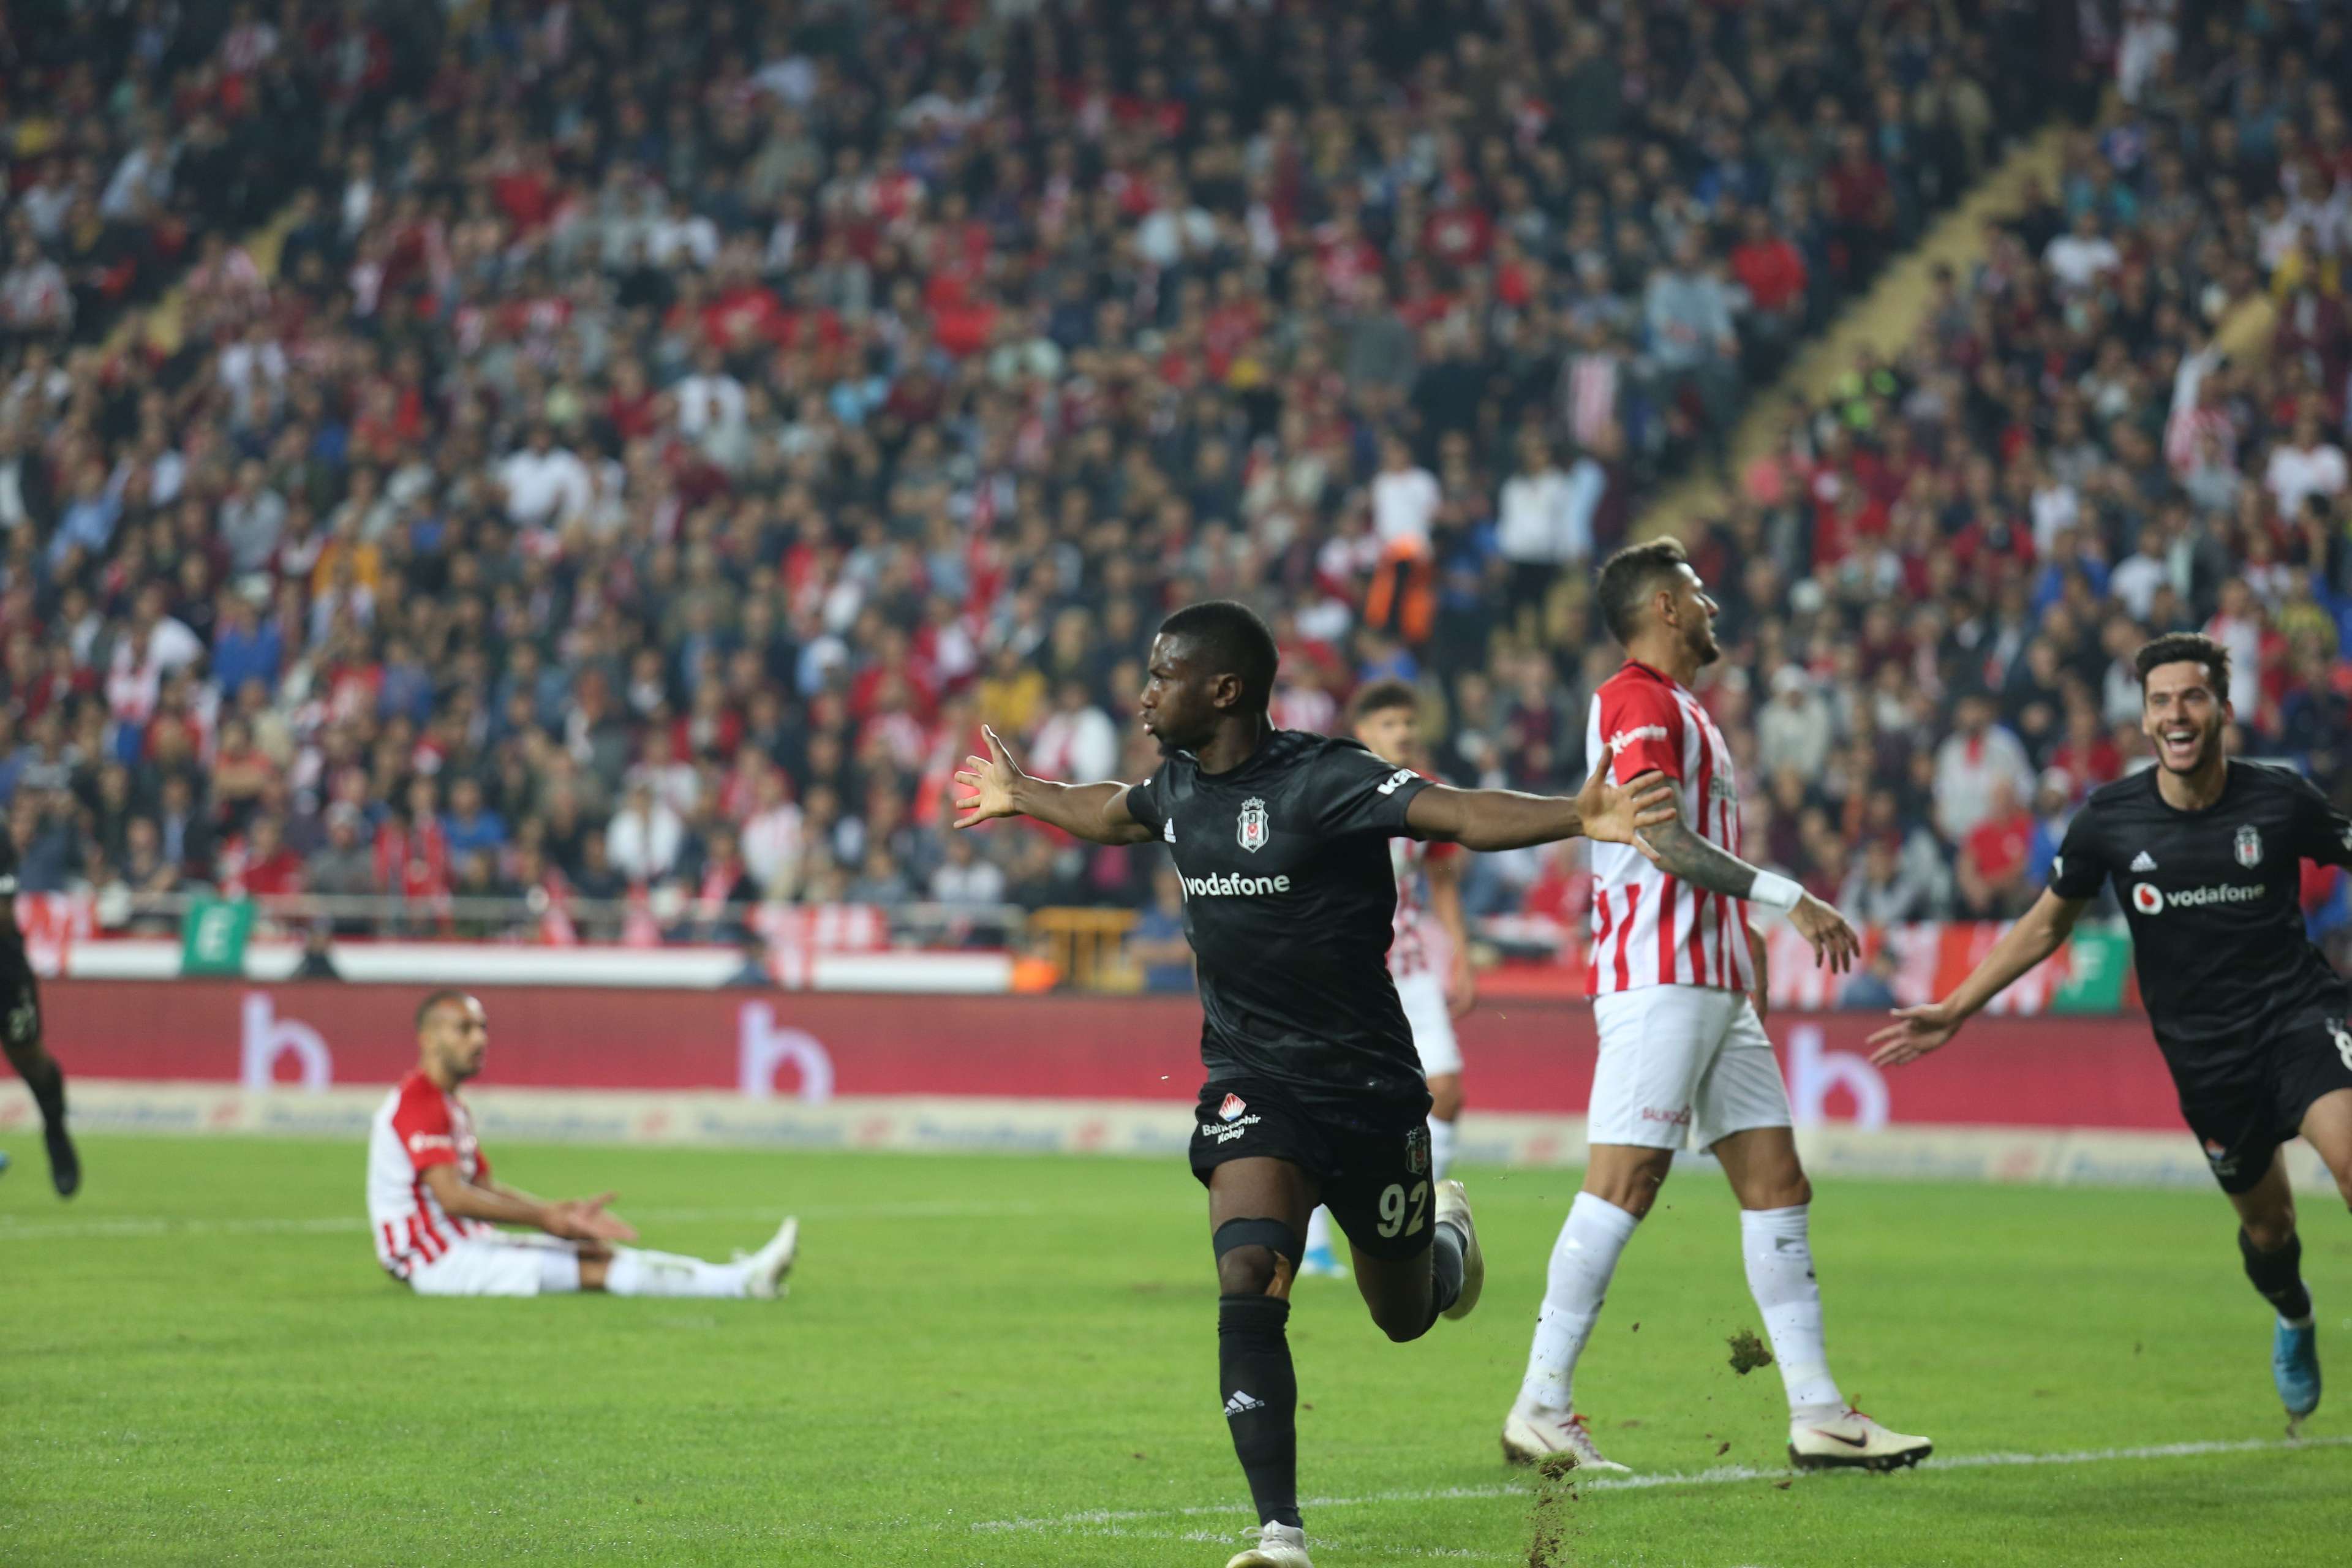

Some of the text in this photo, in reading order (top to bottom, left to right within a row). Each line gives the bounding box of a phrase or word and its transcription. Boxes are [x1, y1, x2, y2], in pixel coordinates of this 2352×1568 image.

[1185, 872, 1291, 896] vodafone
[2166, 883, 2264, 908] vodafone
[1377, 1180, 1428, 1238] 92
